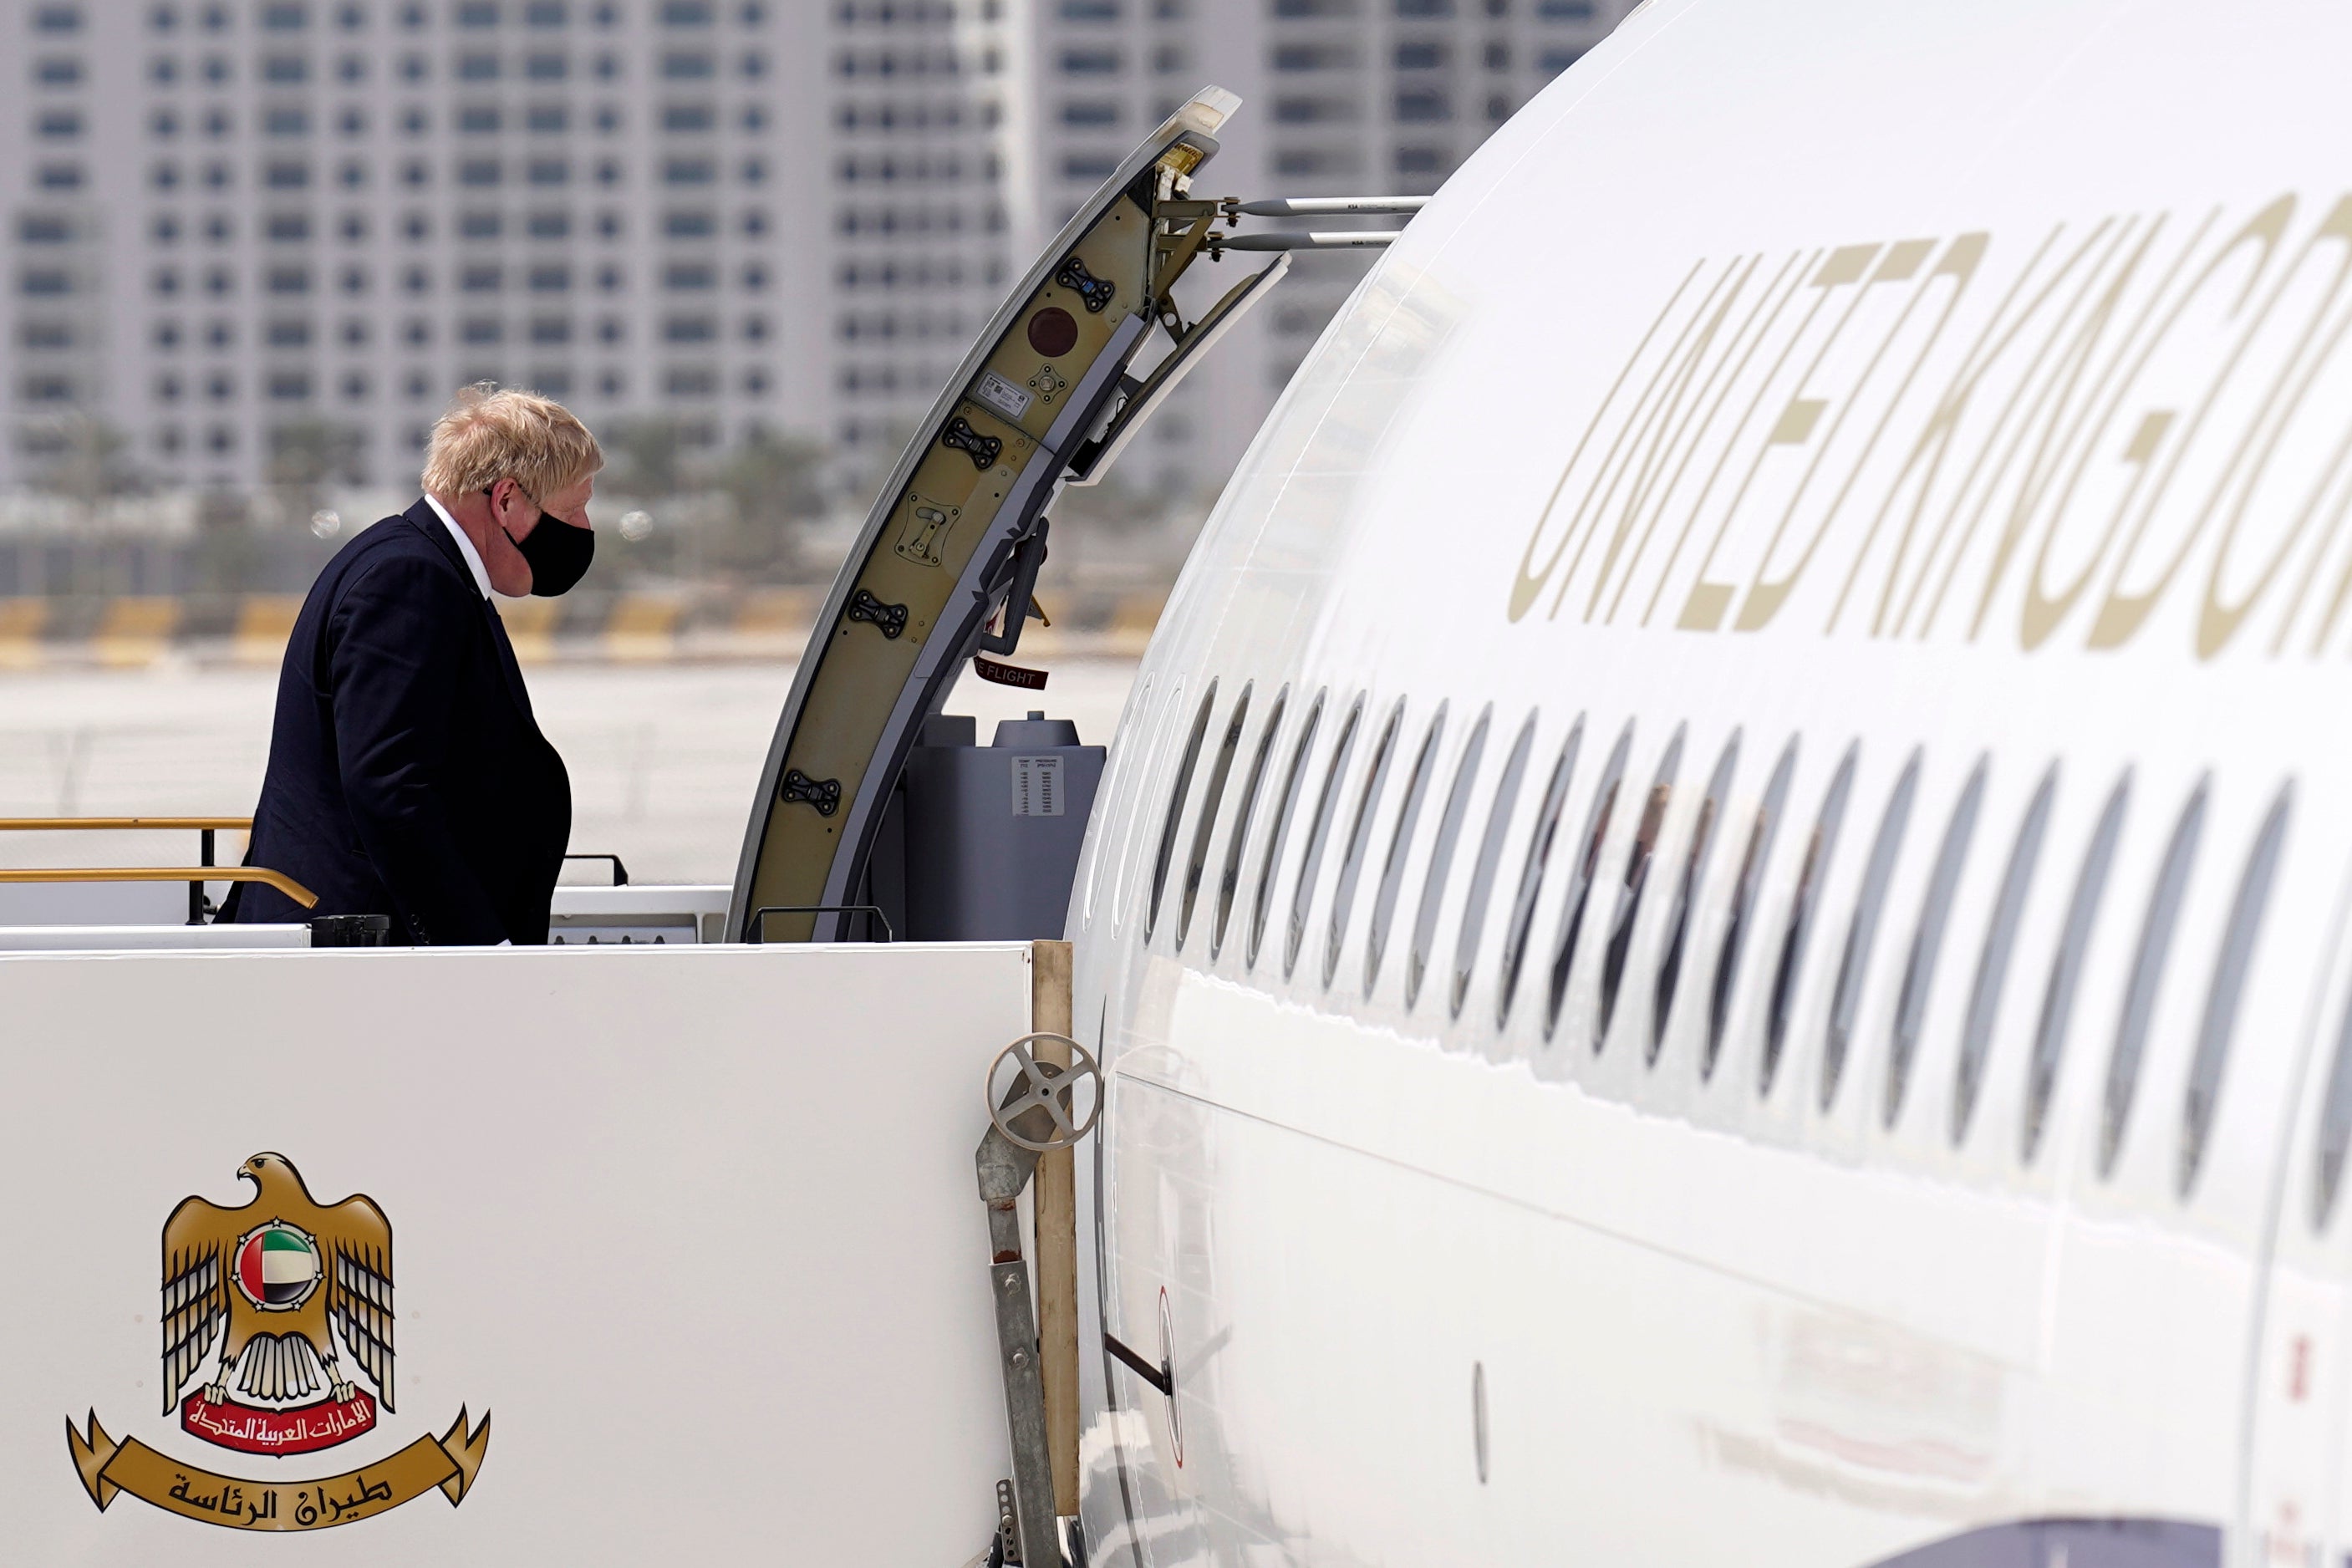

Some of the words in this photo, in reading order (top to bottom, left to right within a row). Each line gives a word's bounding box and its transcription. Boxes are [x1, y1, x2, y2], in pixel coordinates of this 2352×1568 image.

[1507, 229, 1992, 634] UNITED
[1822, 190, 2352, 664] KINGDO
[987, 665, 1036, 685] FLIGHT
[189, 1400, 256, 1440] المتحدة
[256, 1418, 308, 1446] العربية
[168, 1473, 277, 1526] الرئاسة
[295, 1474, 392, 1525] طيران
